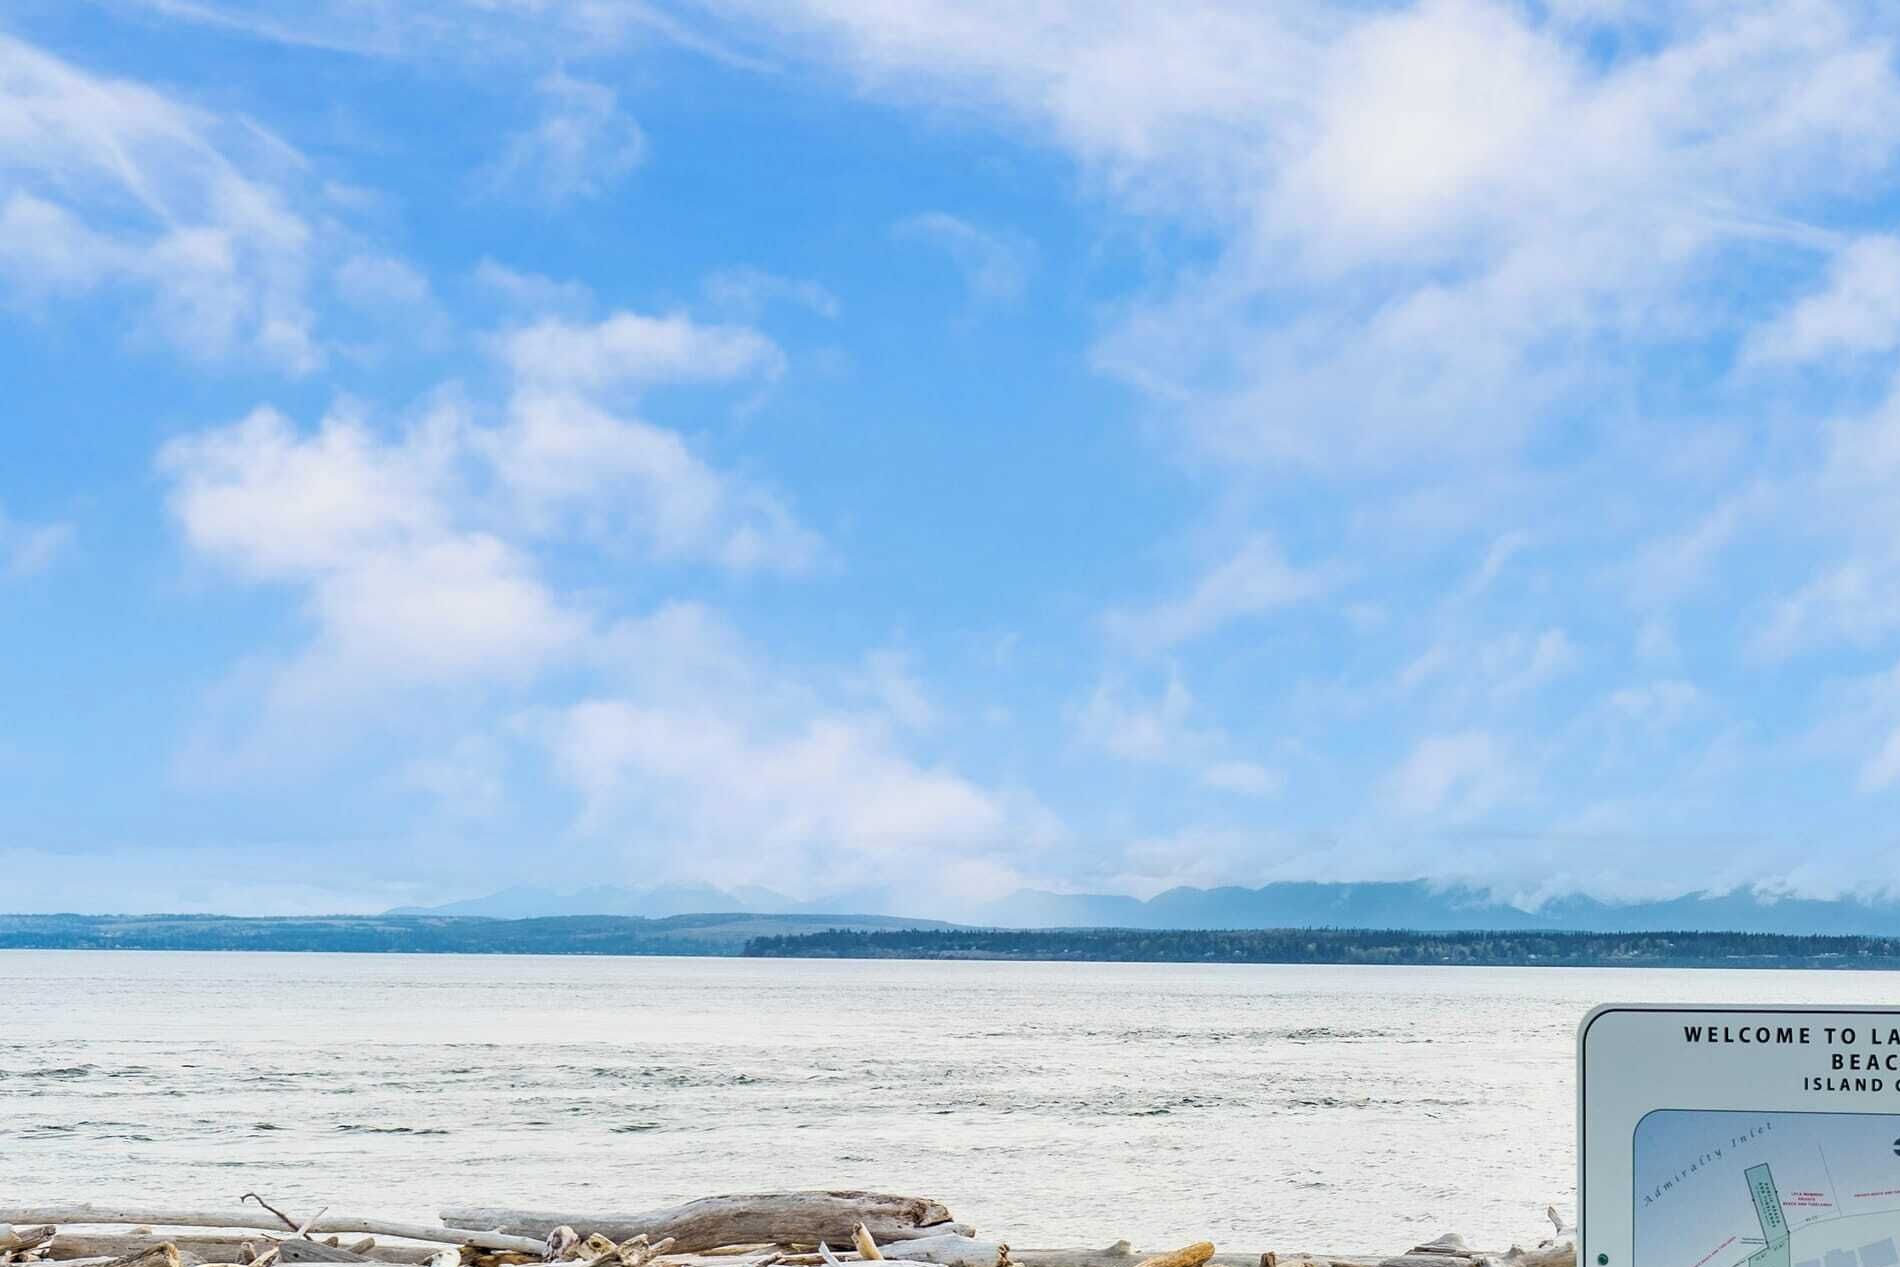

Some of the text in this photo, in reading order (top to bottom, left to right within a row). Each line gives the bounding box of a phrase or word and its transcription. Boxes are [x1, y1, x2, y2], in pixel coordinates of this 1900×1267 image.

[1685, 1026, 1811, 1044] WELCOME
[1824, 1028, 1856, 1045] TO
[1804, 1077, 1884, 1092] ISLAND
[1644, 1148, 1722, 1207] Admiralty
[1731, 1121, 1774, 1148] Inlet
